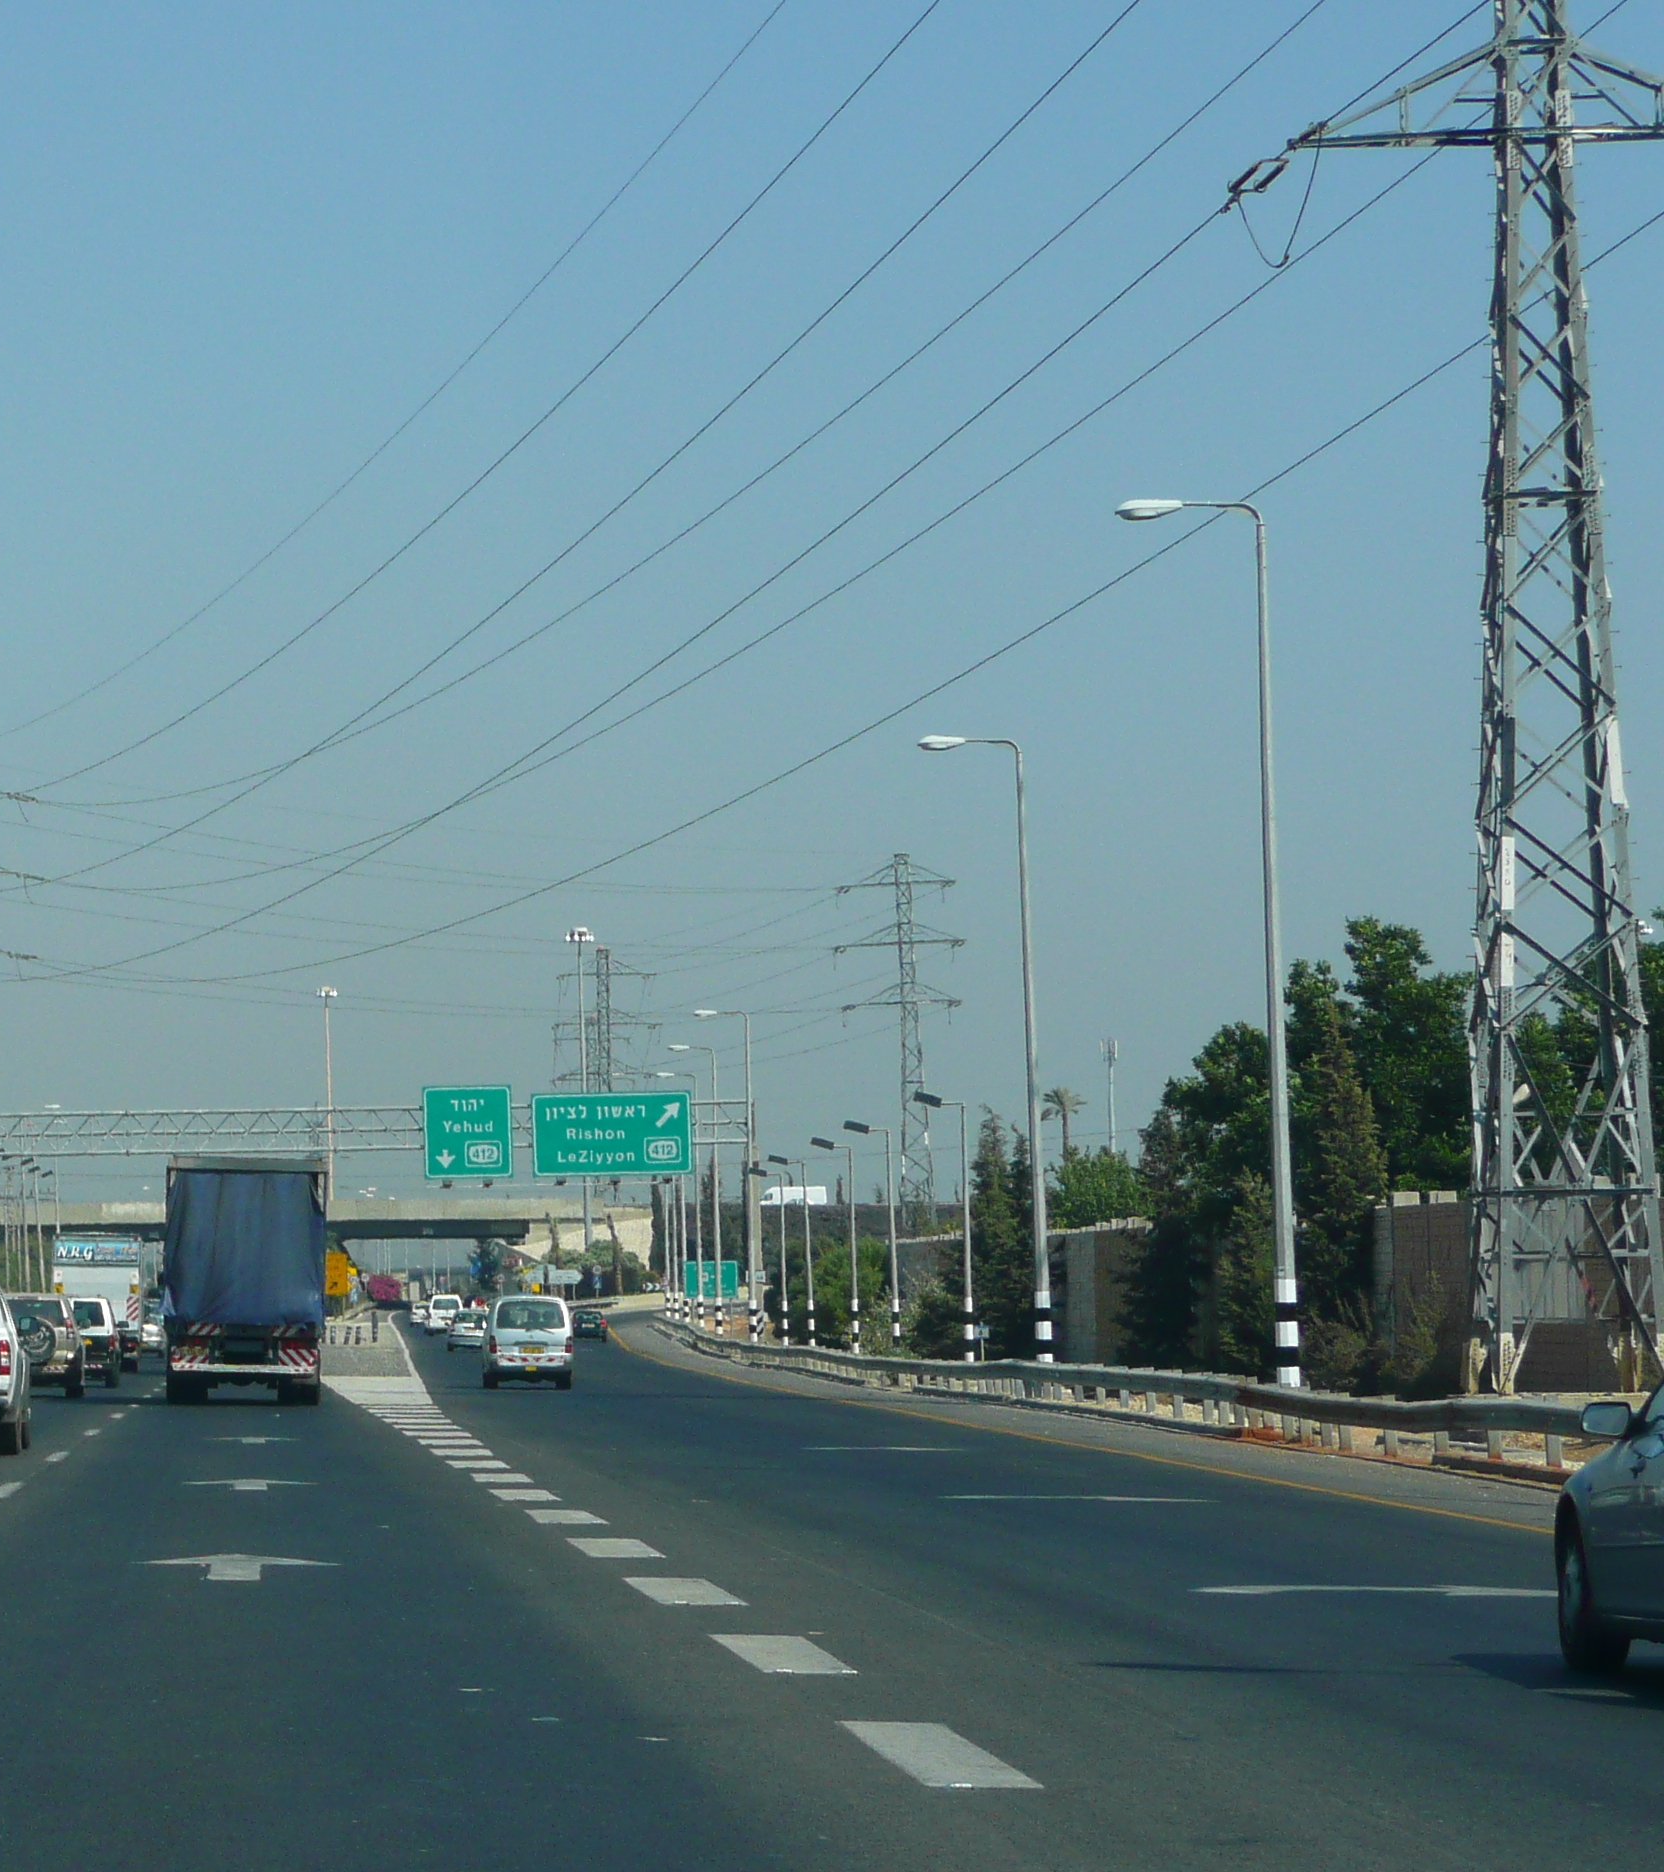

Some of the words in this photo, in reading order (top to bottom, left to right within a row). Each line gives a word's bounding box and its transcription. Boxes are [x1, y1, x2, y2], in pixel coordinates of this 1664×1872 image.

[450, 1099, 485, 1112] יהוד
[545, 1105, 587, 1121] לציון
[597, 1105, 646, 1120] ראשון
[443, 1120, 494, 1133] Yehud
[566, 1128, 626, 1140] Rishon
[472, 1148, 495, 1160] 412
[651, 1144, 674, 1156] 412
[557, 1150, 636, 1164] LeZiyyon
